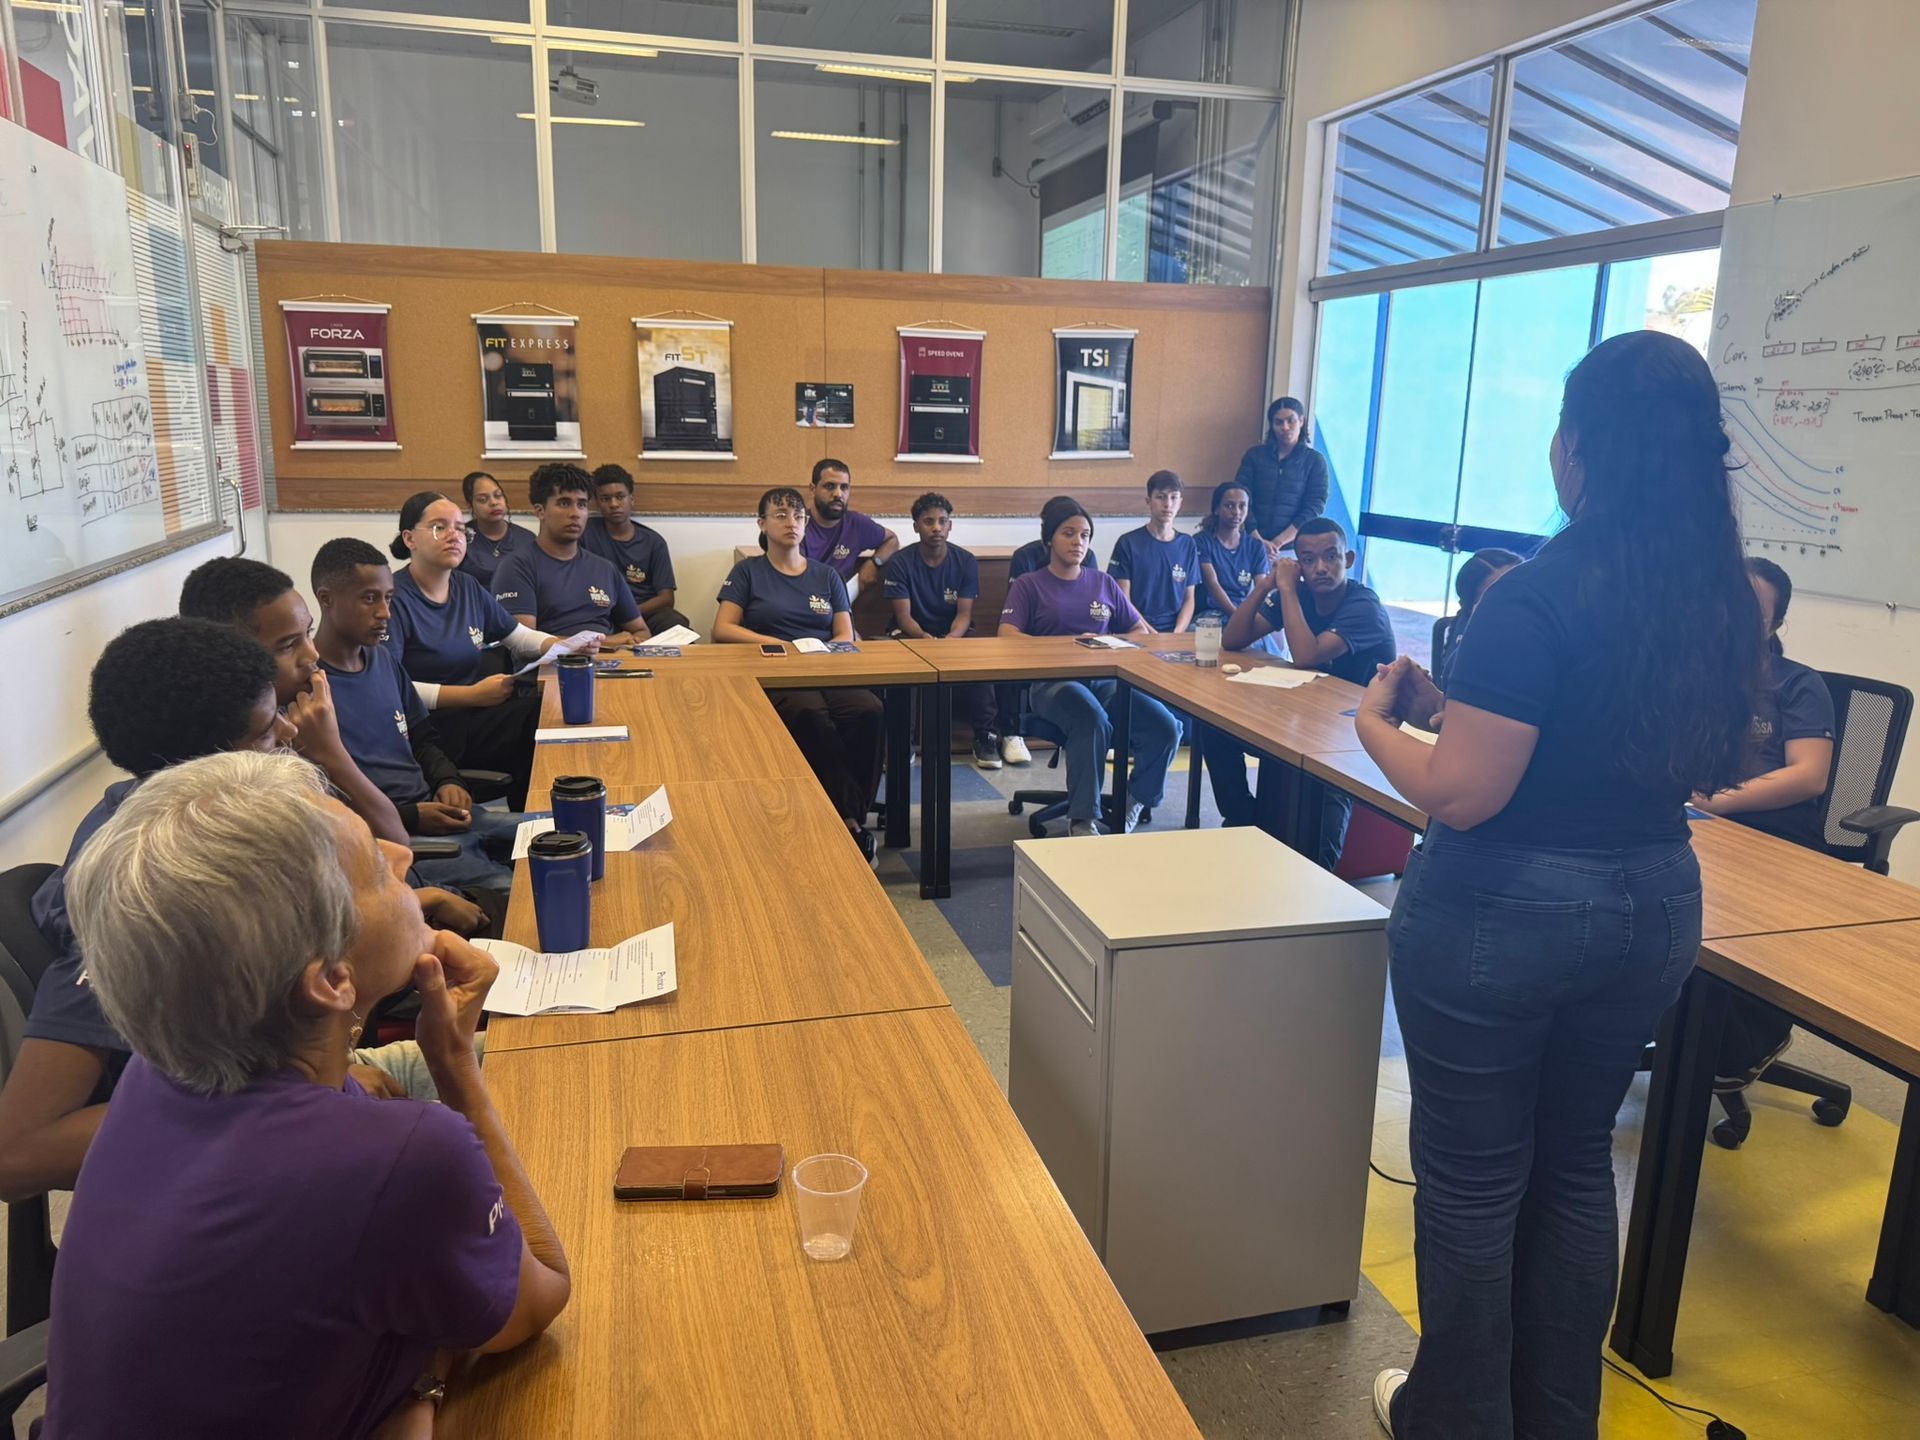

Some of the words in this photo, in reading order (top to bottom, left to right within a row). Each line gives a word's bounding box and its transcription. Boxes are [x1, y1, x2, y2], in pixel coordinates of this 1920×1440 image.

[310, 328, 365, 340] FORZA
[485, 337, 507, 348] FIT
[511, 338, 569, 350] EXPRESS
[664, 352, 681, 361] FIT
[1080, 348, 1109, 367] TSi
